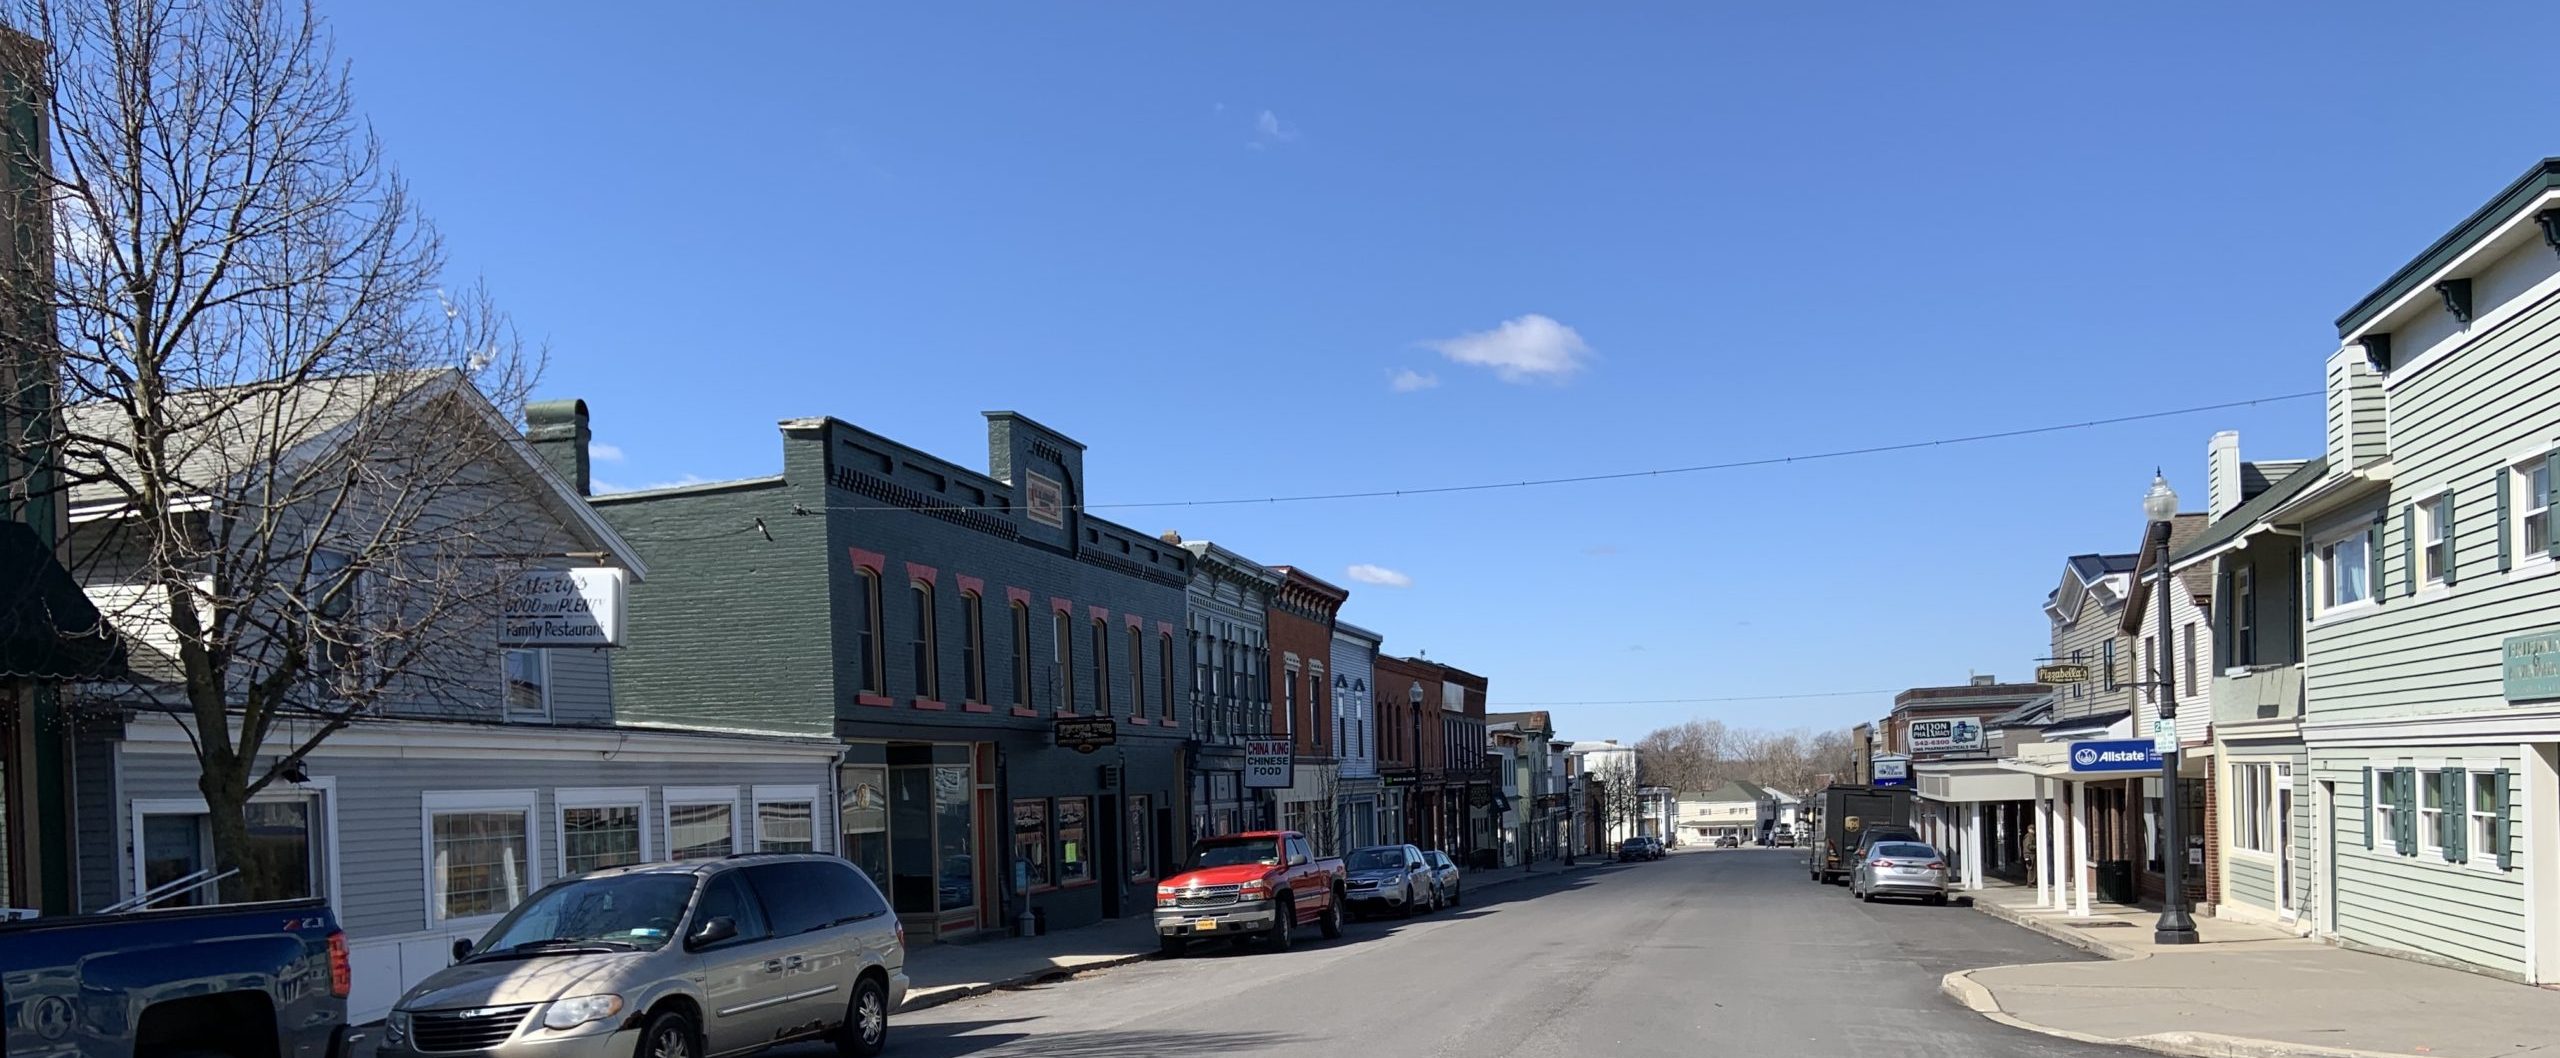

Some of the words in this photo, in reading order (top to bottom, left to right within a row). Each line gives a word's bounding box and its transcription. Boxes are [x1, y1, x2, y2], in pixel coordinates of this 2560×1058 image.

[507, 621, 542, 639] Family
[545, 621, 605, 637] Restaurant
[2039, 667, 2088, 682] Pizzabella's
[1914, 723, 1947, 733] AKRON
[1248, 742, 1269, 755] CHINA
[1271, 742, 1289, 755] KING
[1247, 757, 1289, 765] CHINESE
[2099, 751, 2145, 762] Allstate
[1254, 767, 1282, 775] FOOD
